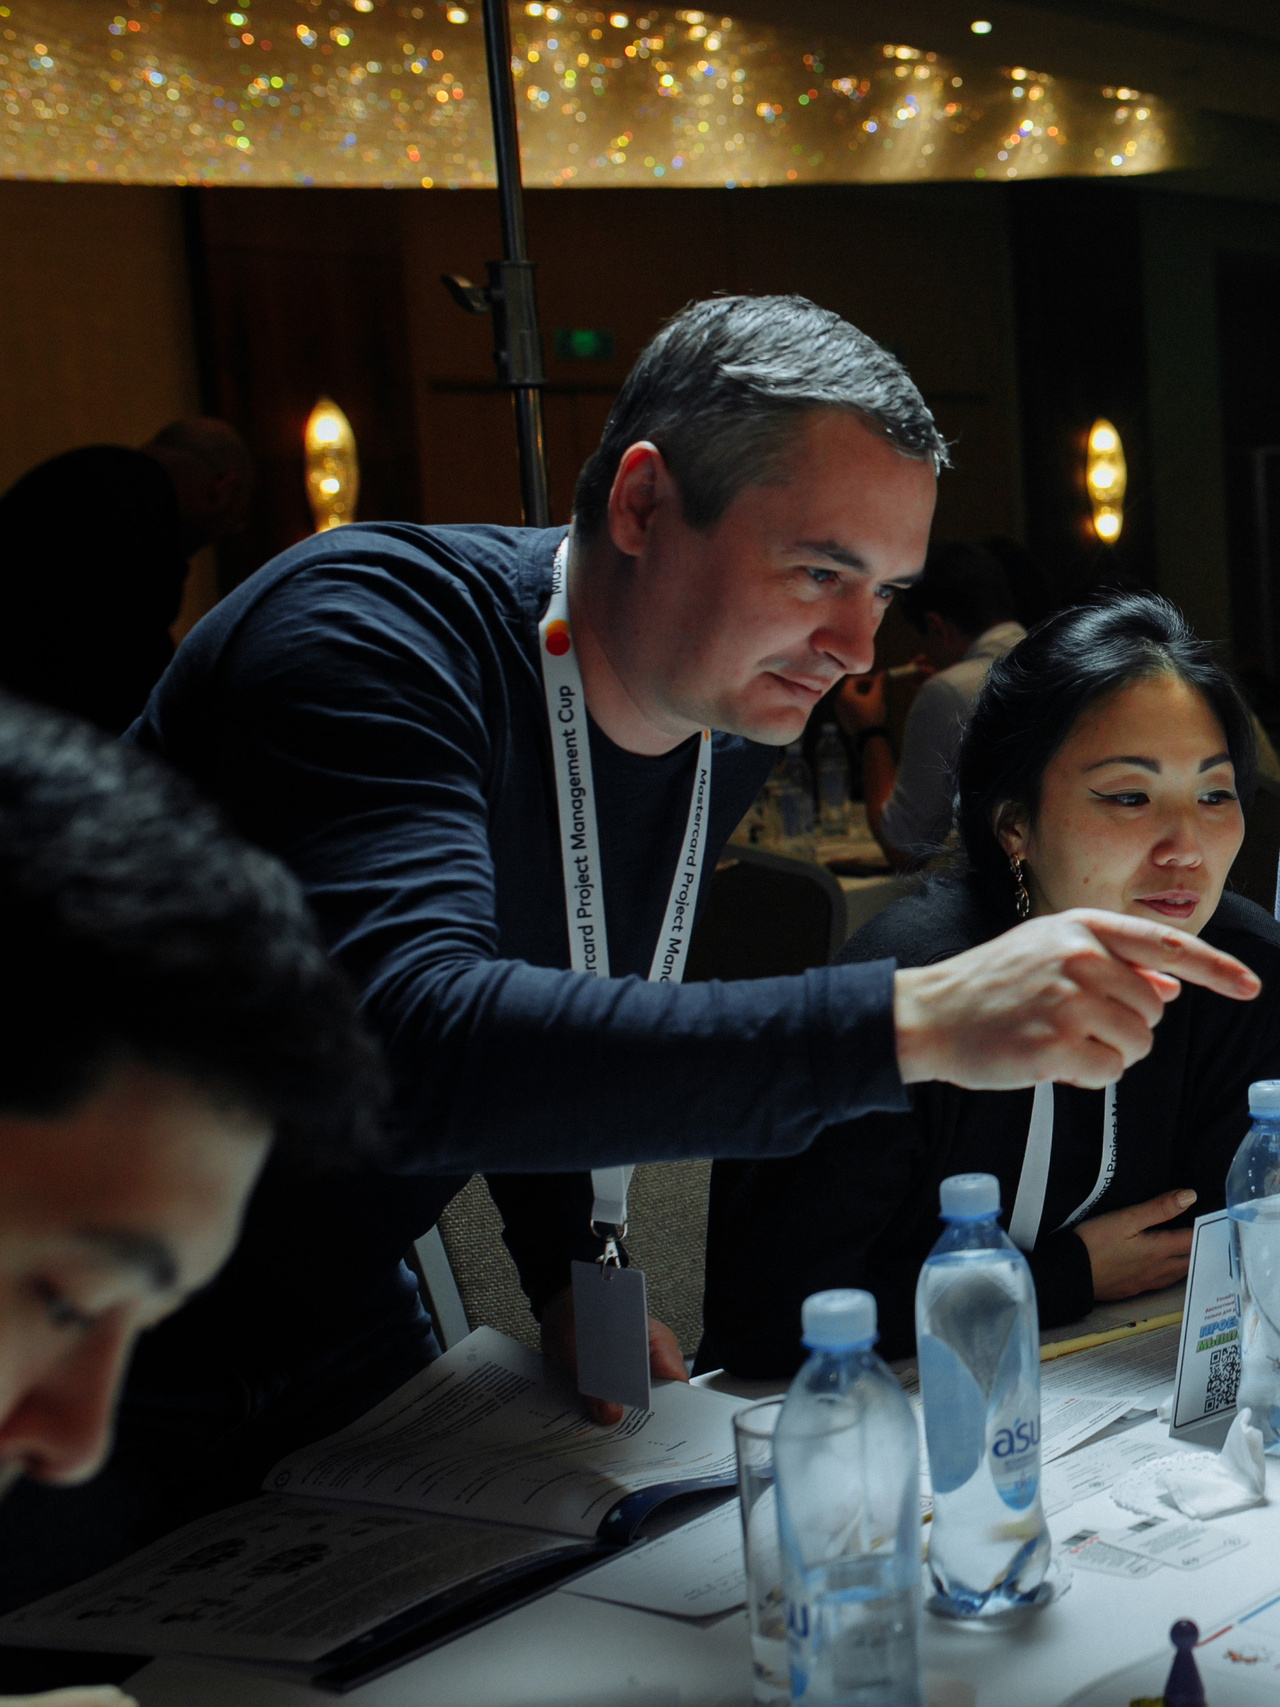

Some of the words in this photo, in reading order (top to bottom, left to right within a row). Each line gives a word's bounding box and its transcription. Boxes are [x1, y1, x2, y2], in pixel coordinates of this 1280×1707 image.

[558, 685, 576, 724] Cup
[562, 728, 588, 850] Management
[686, 768, 707, 867] Mastercard
[574, 855, 594, 919] Project
[671, 872, 695, 933] Project
